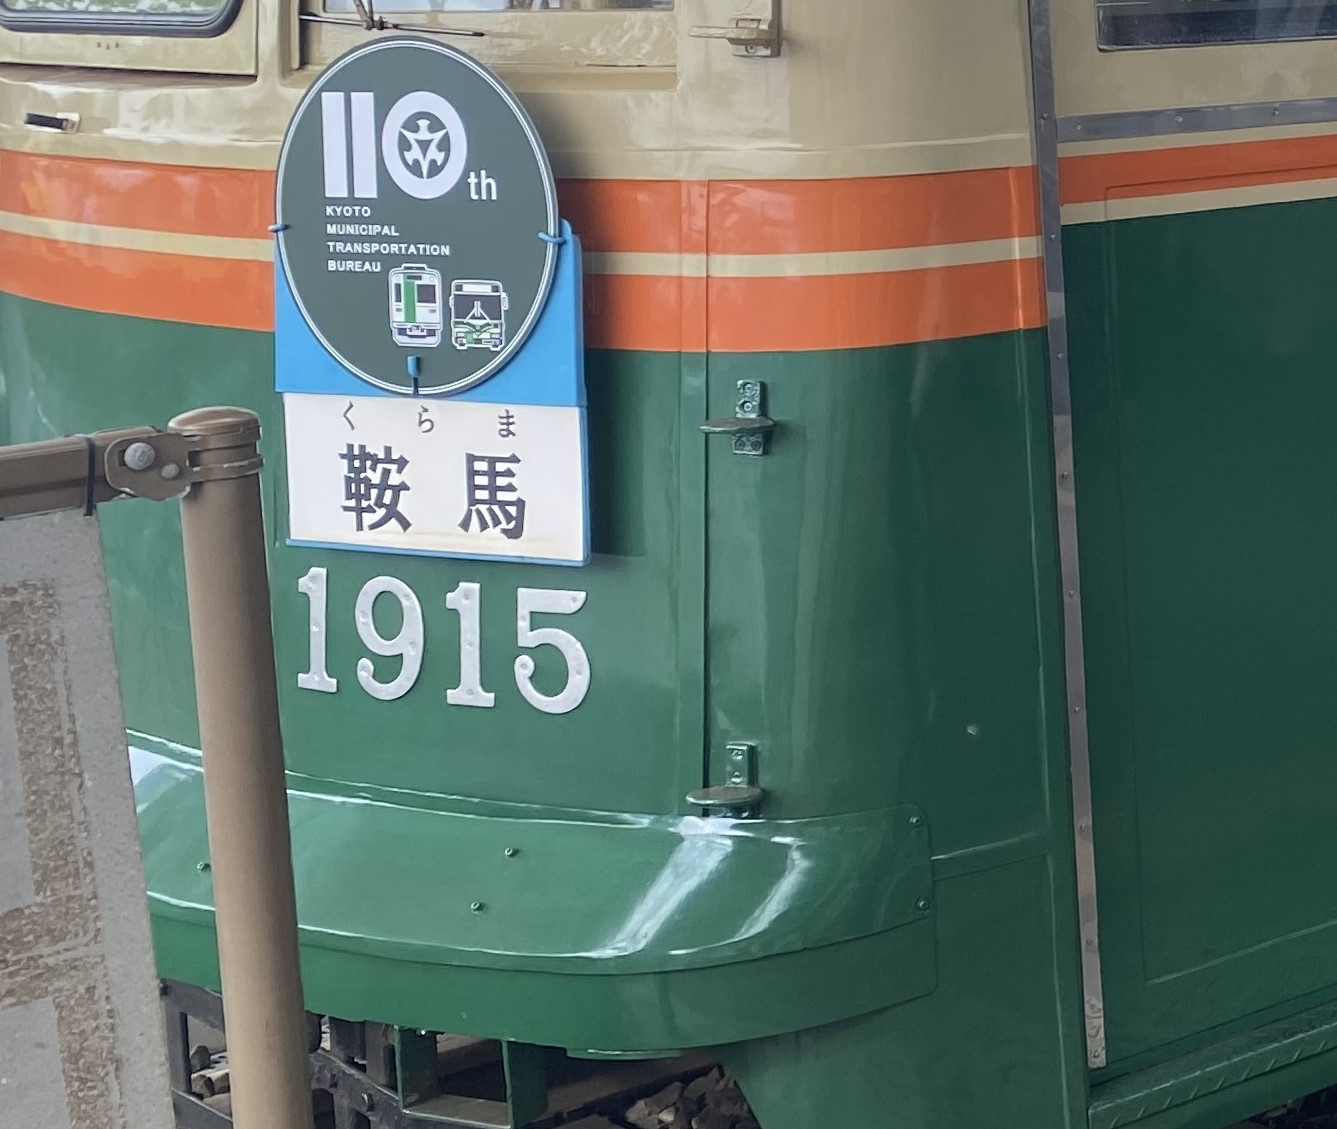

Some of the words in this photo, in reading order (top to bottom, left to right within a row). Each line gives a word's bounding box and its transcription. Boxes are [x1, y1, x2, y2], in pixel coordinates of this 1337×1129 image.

[326, 205, 371, 217] KYOTO
[326, 223, 400, 237] MUNICIPAL
[327, 241, 451, 256] TRANSPORTATION
[327, 259, 381, 272] BUREAU
[297, 566, 591, 715] 1915
